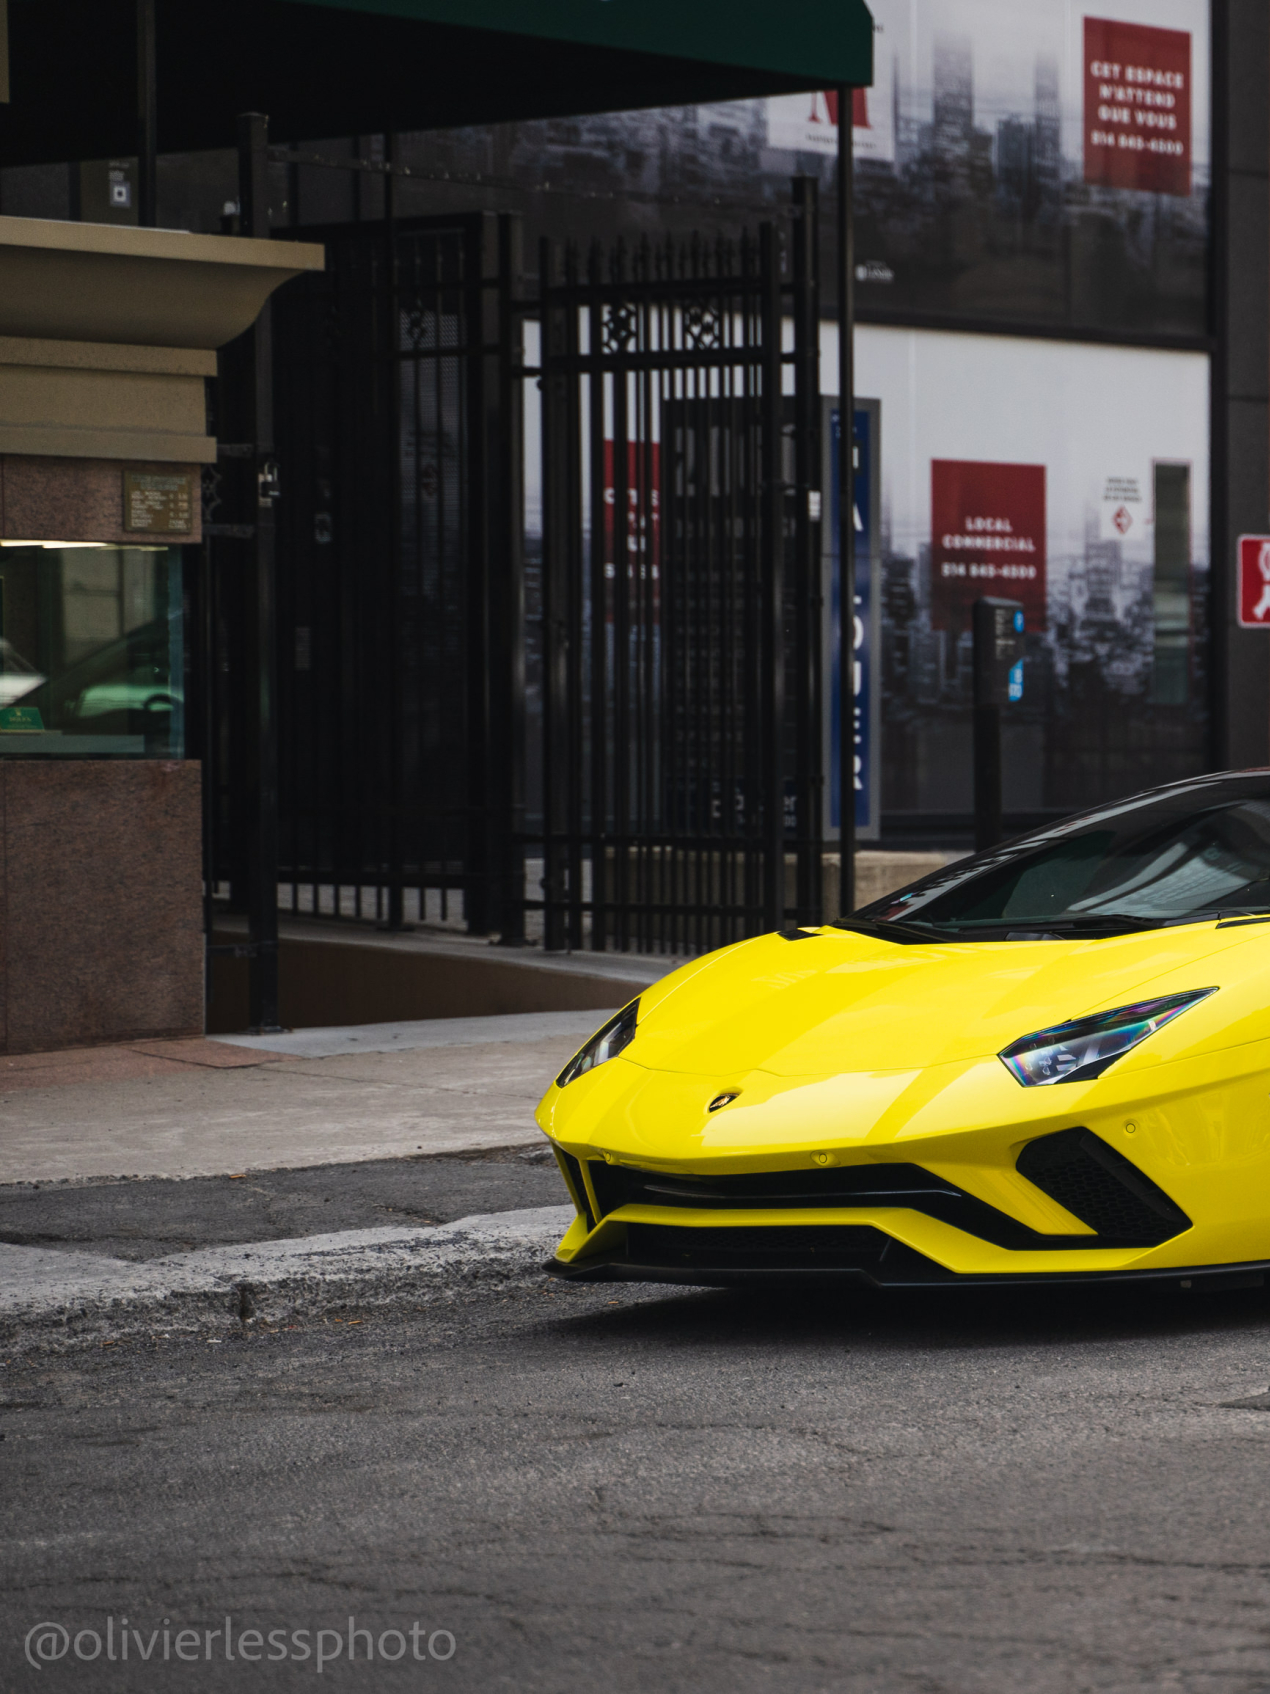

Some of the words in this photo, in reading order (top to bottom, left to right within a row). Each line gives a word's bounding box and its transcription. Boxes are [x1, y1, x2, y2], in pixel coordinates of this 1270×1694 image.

[1091, 61, 1120, 79] CET
[1125, 65, 1184, 89] ESPACE
[1098, 105, 1131, 124] QUE
[1134, 109, 1177, 130] VOUS
[965, 516, 1013, 532] LOCAL
[942, 534, 1036, 552] COMMERCIAL
